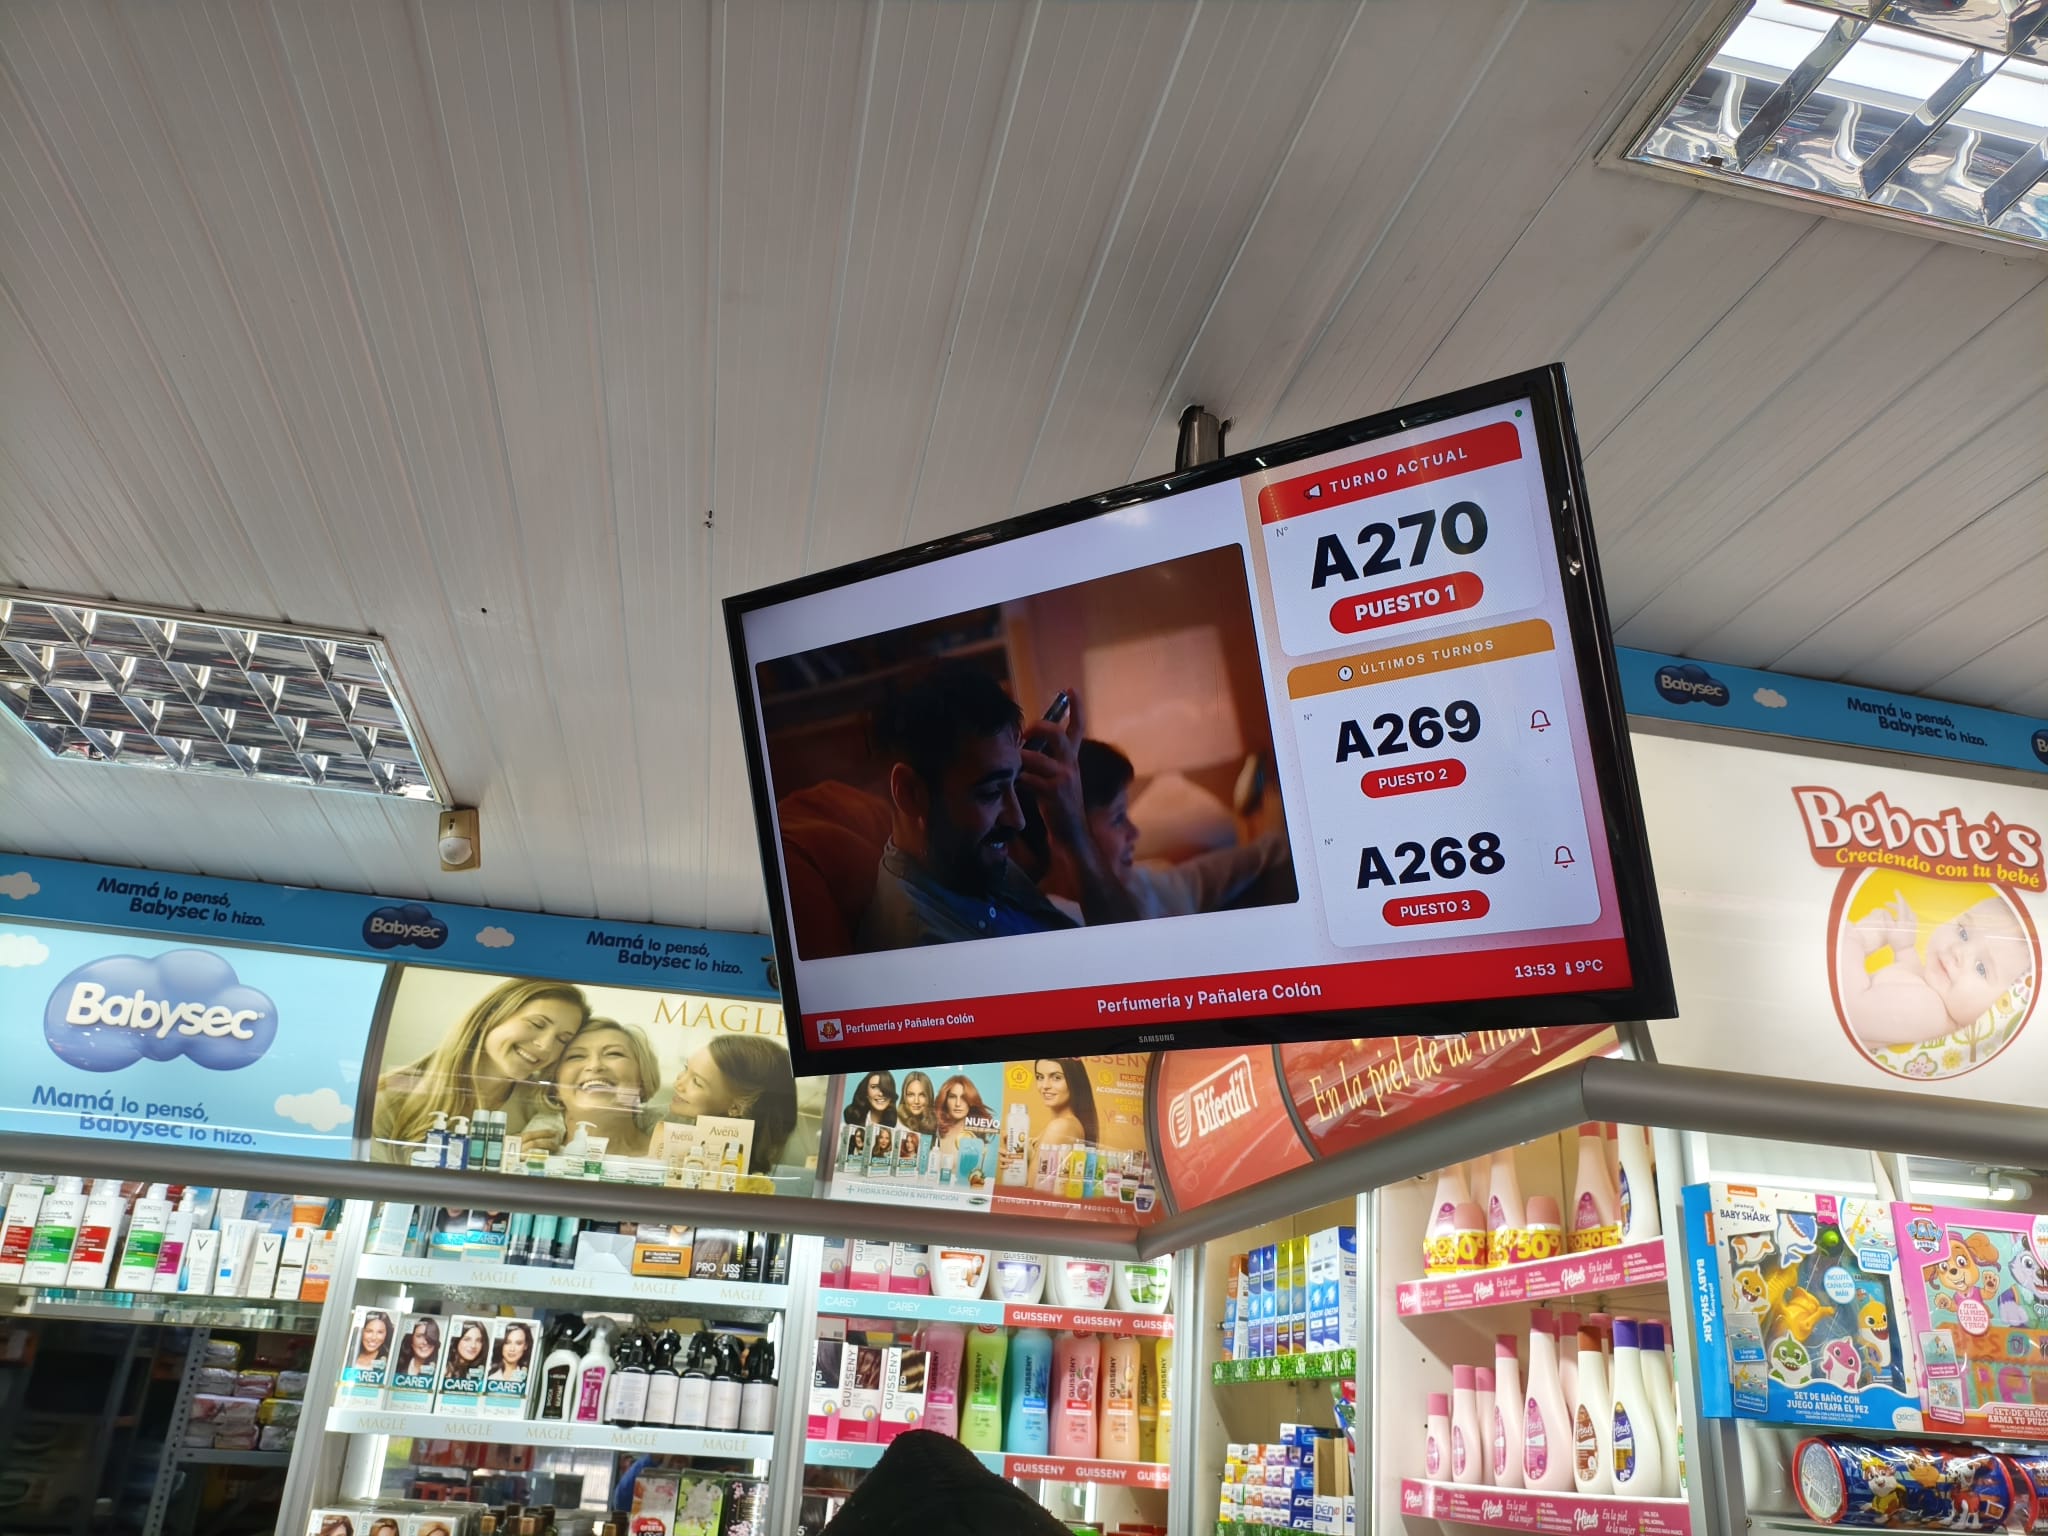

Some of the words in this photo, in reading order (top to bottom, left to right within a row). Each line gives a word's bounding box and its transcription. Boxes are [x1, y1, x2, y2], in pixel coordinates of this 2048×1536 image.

[1329, 467, 1388, 493] TURNO
[1396, 447, 1468, 475] ACTUAL
[1311, 500, 1488, 590] A270
[1354, 589, 1440, 621] PUESTO
[1445, 585, 1456, 601] 1
[1360, 652, 1425, 675] ÚLTIMOS
[1432, 640, 1495, 661] TURNOS
[1661, 674, 1723, 698] Babysec
[1847, 698, 1897, 718] Mamá
[1901, 708, 1912, 720] lo
[1915, 711, 1955, 729] pensó,
[1336, 700, 1481, 763] A269
[1878, 716, 1942, 741] Babysec
[1945, 728, 1957, 741] lo
[1960, 731, 1988, 747] hizo.
[1378, 770, 1435, 789] PUESTO
[1439, 767, 1448, 781] 2
[1798, 791, 2040, 868] Bebote's
[1357, 832, 1505, 889] A268
[1835, 847, 1930, 873] Creciendo
[1935, 863, 1968, 878] con
[1973, 864, 1991, 879] tu
[1996, 866, 2040, 888] bebé
[97, 877, 160, 898] Mamá
[164, 887, 178, 900] lo
[182, 890, 231, 908] pensó,
[129, 898, 209, 921] Babysec
[213, 908, 227, 923] lo
[231, 911, 265, 927] hizo.
[1400, 901, 1457, 918] PUESTO
[1461, 900, 1471, 912] 3
[370, 916, 441, 940] Babysec
[586, 931, 643, 951] Mamá
[649, 938, 661, 951] lo
[665, 941, 711, 958] pensó,
[617, 948, 691, 971] Babysec
[695, 957, 708, 971] lo
[712, 959, 743, 975] hizo.
[1514, 963, 1556, 978] 13:53
[1575, 959, 1604, 973] 9°C
[1097, 993, 1181, 1014] Perfumería
[1184, 995, 1194, 1011] y
[1198, 985, 1268, 1006] Pañalera
[1272, 980, 1322, 1000] Colón
[66, 982, 258, 1040] Babysec
[896, 1021, 903, 1032] y
[905, 1016, 945, 1030] Pañalera
[946, 1012, 974, 1026] Colón
[1138, 1033, 1175, 1043] SAMSUNG
[1309, 1075, 1344, 1122] En
[1339, 1061, 1368, 1111] la
[1368, 1036, 1410, 1118] piel
[1413, 1036, 1442, 1082] de
[32, 1085, 114, 1111] Mamá
[121, 1096, 139, 1114] lo
[145, 1100, 209, 1123] pensó,
[1193, 1067, 1251, 1137] Biferdil
[80, 1111, 183, 1139] Babysec
[190, 1126, 206, 1141] lo
[214, 1126, 256, 1147] hizo.
[709, 1126, 740, 1138] Avena
[964, 1117, 1000, 1129] NUEVO
[1720, 1208, 1741, 1219] BABY
[1742, 1210, 1771, 1223] SHARK
[696, 1262, 716, 1273] PRO
[1696, 1258, 1708, 1293] BABY
[824, 1295, 858, 1308] CAREY
[887, 1301, 920, 1312] CAREY
[948, 1305, 981, 1317] CAREY
[1012, 1310, 1063, 1323] GUISSENY
[1073, 1315, 1123, 1328] GUISSENY
[1700, 1294, 1713, 1344] SHARK
[395, 1375, 432, 1388] CAREY
[444, 1379, 482, 1392] CAREY
[487, 1380, 526, 1393] CAREY
[842, 1350, 857, 1407] GUISSENY
[885, 1351, 899, 1410] GUISSENY
[1787, 1400, 1814, 1409] JUEGO
[1815, 1402, 1844, 1412] ATRAPA
[1844, 1404, 1854, 1412] EL
[1855, 1405, 1869, 1414] PEZ
[1794, 1391, 1809, 1400] SET
[1810, 1392, 1820, 1400] DE
[1821, 1392, 1843, 1402] BAÑO
[1844, 1395, 1860, 1404] CON
[1013, 1462, 1065, 1475] GUISSENY
[1076, 1466, 1127, 1479] GUISSENY
[1137, 1471, 1170, 1482] GUISS
